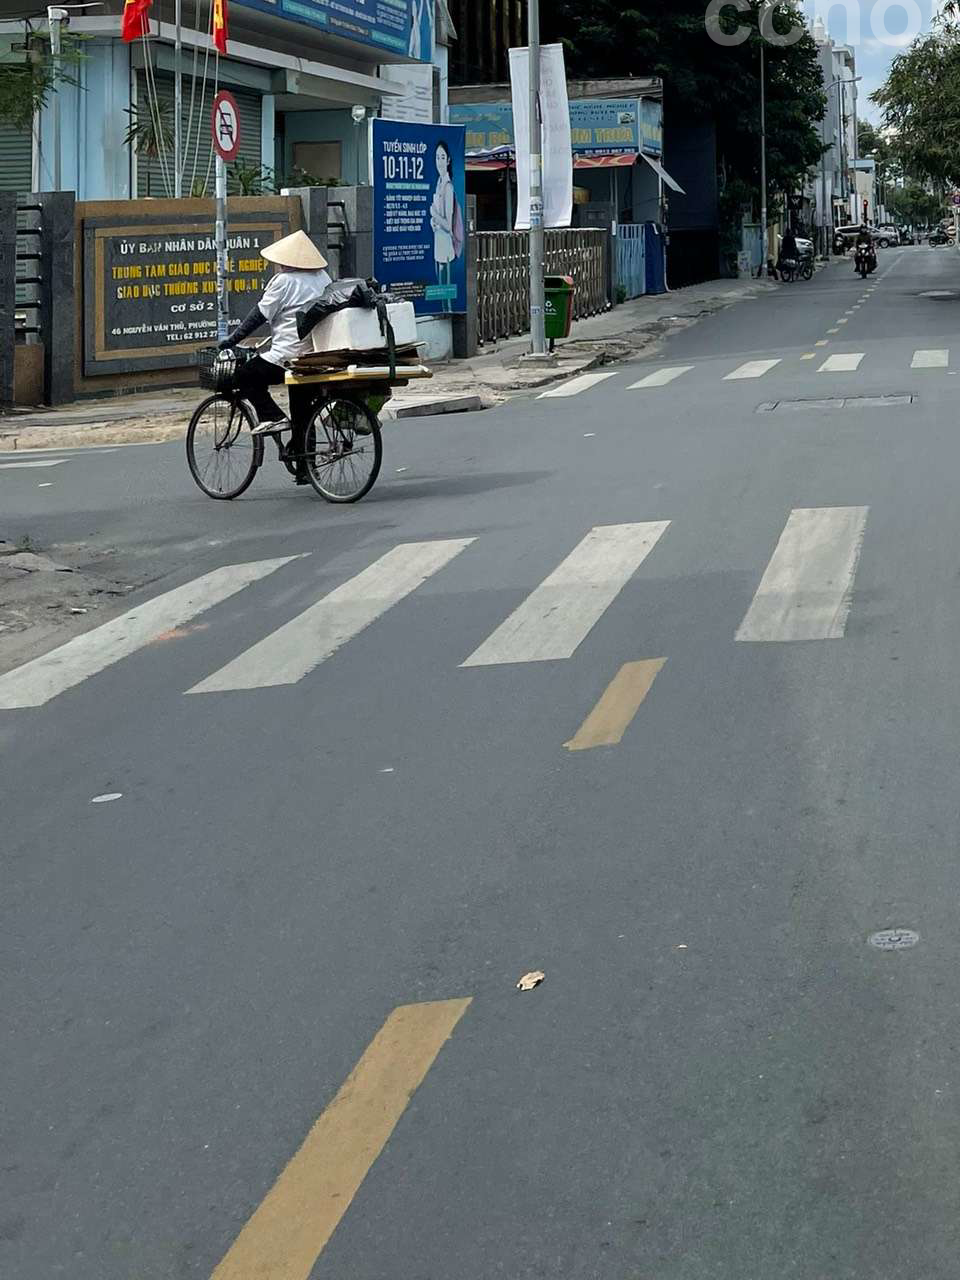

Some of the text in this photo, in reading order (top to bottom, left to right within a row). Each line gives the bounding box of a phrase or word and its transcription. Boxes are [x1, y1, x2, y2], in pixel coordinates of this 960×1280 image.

[165, 238, 195, 253] NHÂN
[253, 237, 260, 248] 1
[112, 266, 142, 279] TRUNG
[170, 300, 214, 313] CƠ SỞ 2
